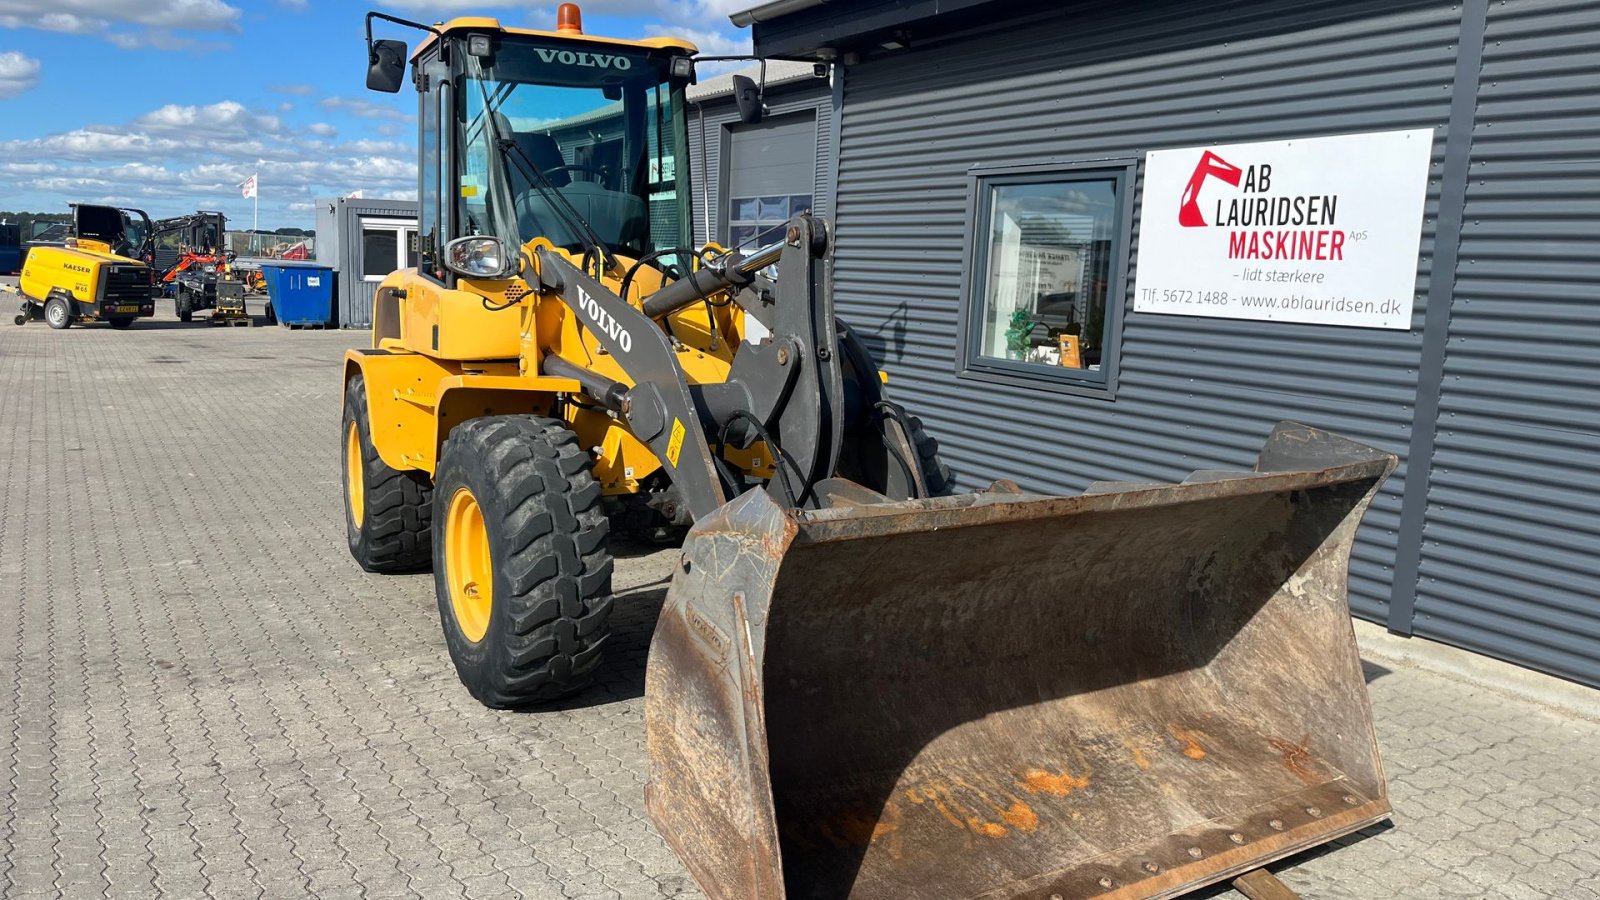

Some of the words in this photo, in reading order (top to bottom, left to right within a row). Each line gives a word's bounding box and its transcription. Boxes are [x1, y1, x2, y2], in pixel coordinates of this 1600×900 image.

[533, 47, 632, 71] VOLVO
[1243, 163, 1272, 193] AB
[1215, 195, 1337, 227] LAURIDSEN
[1228, 230, 1345, 261] MASKINER
[1348, 230, 1368, 241] ApS
[63, 262, 91, 274] KAESER
[1242, 267, 1263, 282] lidt
[1265, 269, 1325, 284] stærkere
[1141, 287, 1160, 305] Tlf.
[1240, 293, 1402, 316] www.ablauridsen.dk
[576, 284, 632, 353] VOLVO
